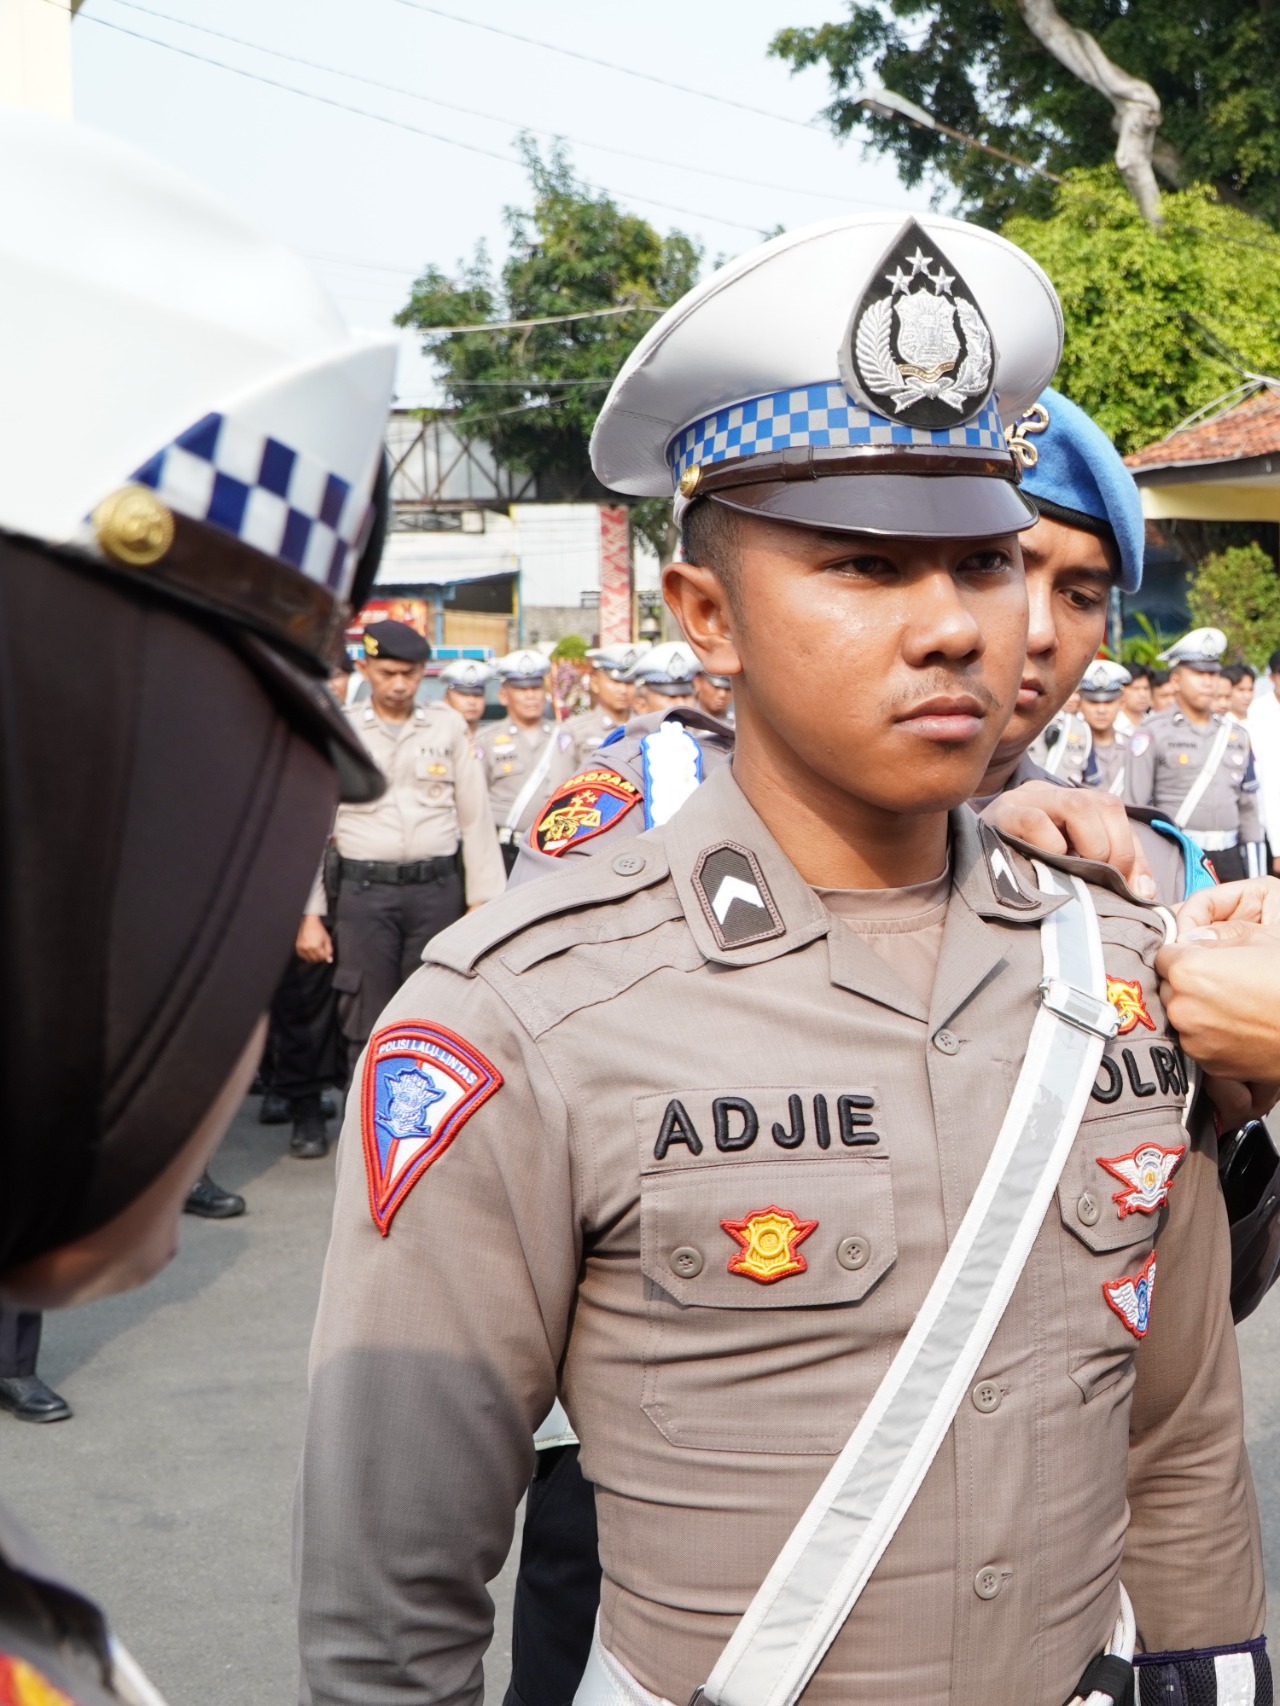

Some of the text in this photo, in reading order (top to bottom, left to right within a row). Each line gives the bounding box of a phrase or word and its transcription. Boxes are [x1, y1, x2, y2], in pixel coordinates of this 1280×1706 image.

[563, 773, 636, 793] PROPAM
[379, 1039, 412, 1054] POLISI
[1091, 1046, 1189, 1105] OLRI
[654, 1093, 881, 1160] ADJIE
